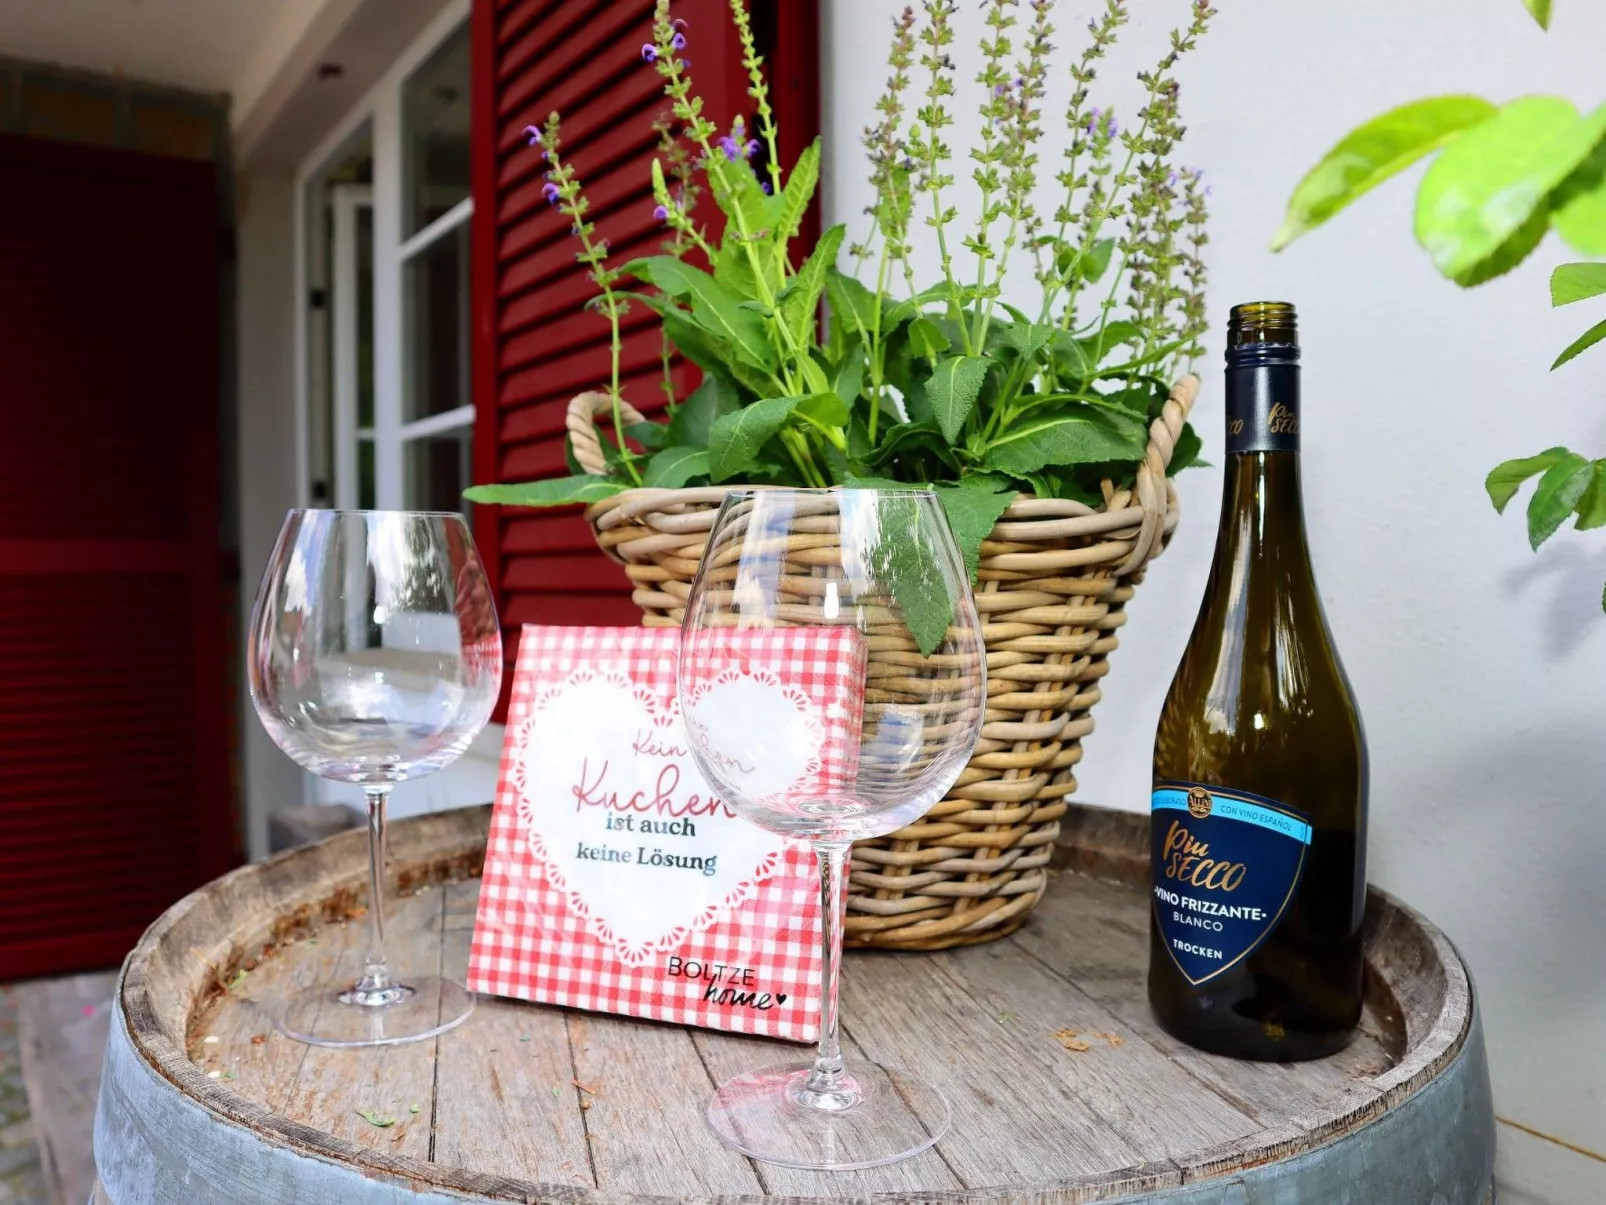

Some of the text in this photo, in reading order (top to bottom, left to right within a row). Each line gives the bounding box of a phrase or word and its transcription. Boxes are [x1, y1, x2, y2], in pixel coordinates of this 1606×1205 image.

[632, 728, 687, 757] Kein
[572, 757, 737, 818] Kuchen
[606, 811, 696, 837] ist auch
[1220, 805, 1237, 815] CON
[1239, 809, 1258, 820] VINO
[576, 842, 718, 876] keine Lösung
[1166, 851, 1247, 891] SECCO
[1173, 911, 1223, 931] BLANCO
[1173, 939, 1223, 959] TROCKEN
[668, 956, 755, 986] BOLTZE
[703, 974, 773, 1010] home
